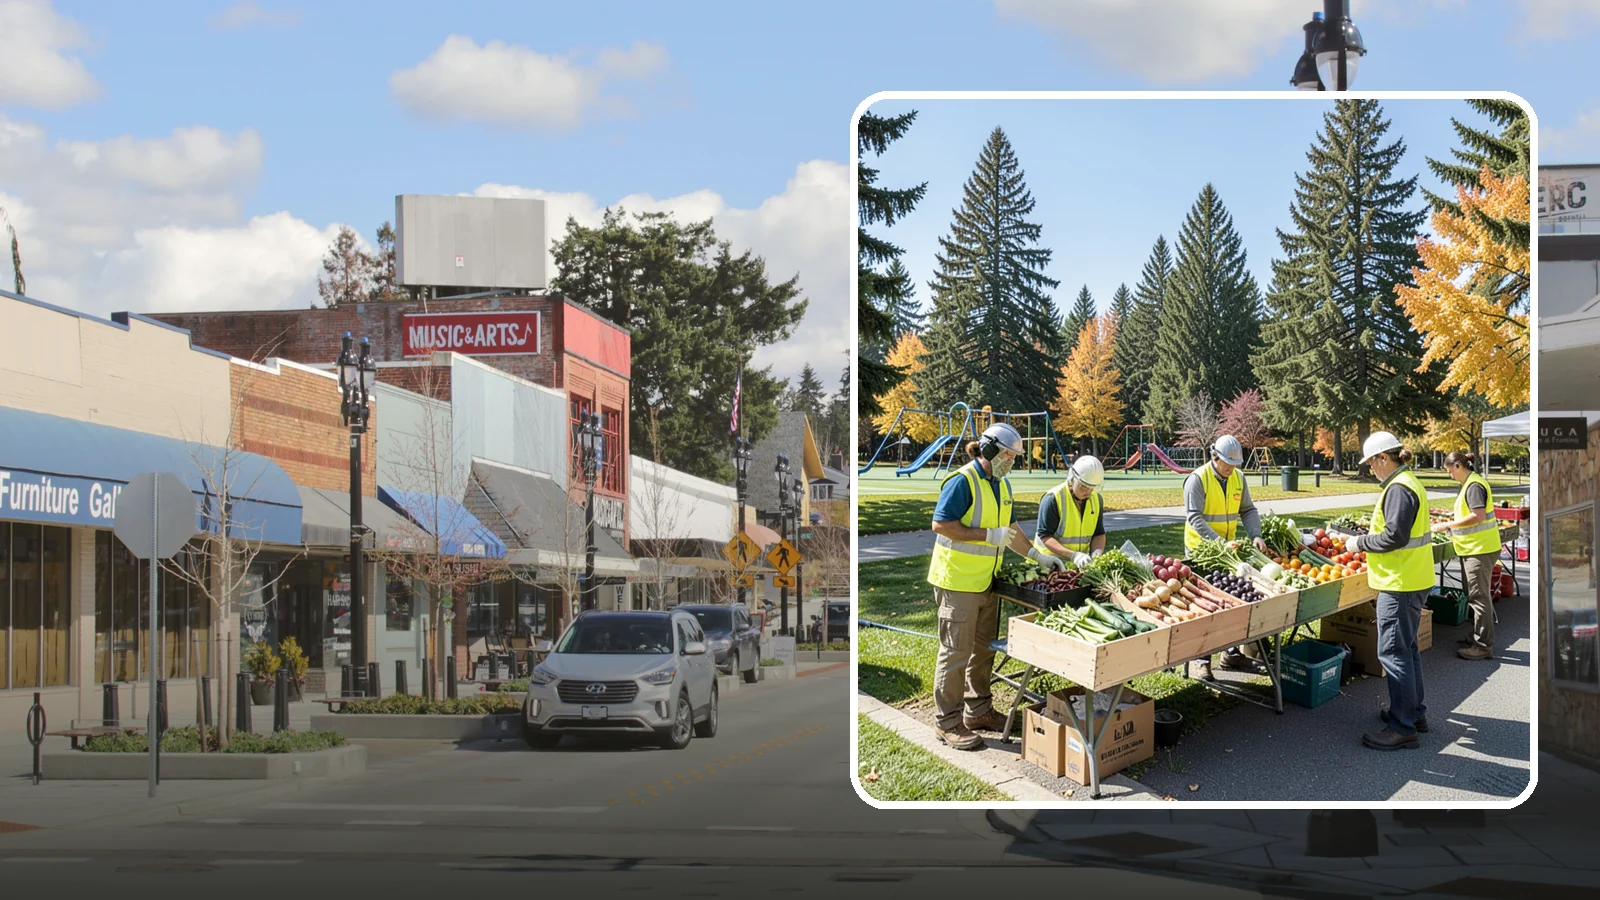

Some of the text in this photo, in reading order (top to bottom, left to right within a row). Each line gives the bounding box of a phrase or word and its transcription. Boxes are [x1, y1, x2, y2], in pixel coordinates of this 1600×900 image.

[0, 471, 122, 519] Furniture Gal
[454, 562, 479, 574] SUSHI
